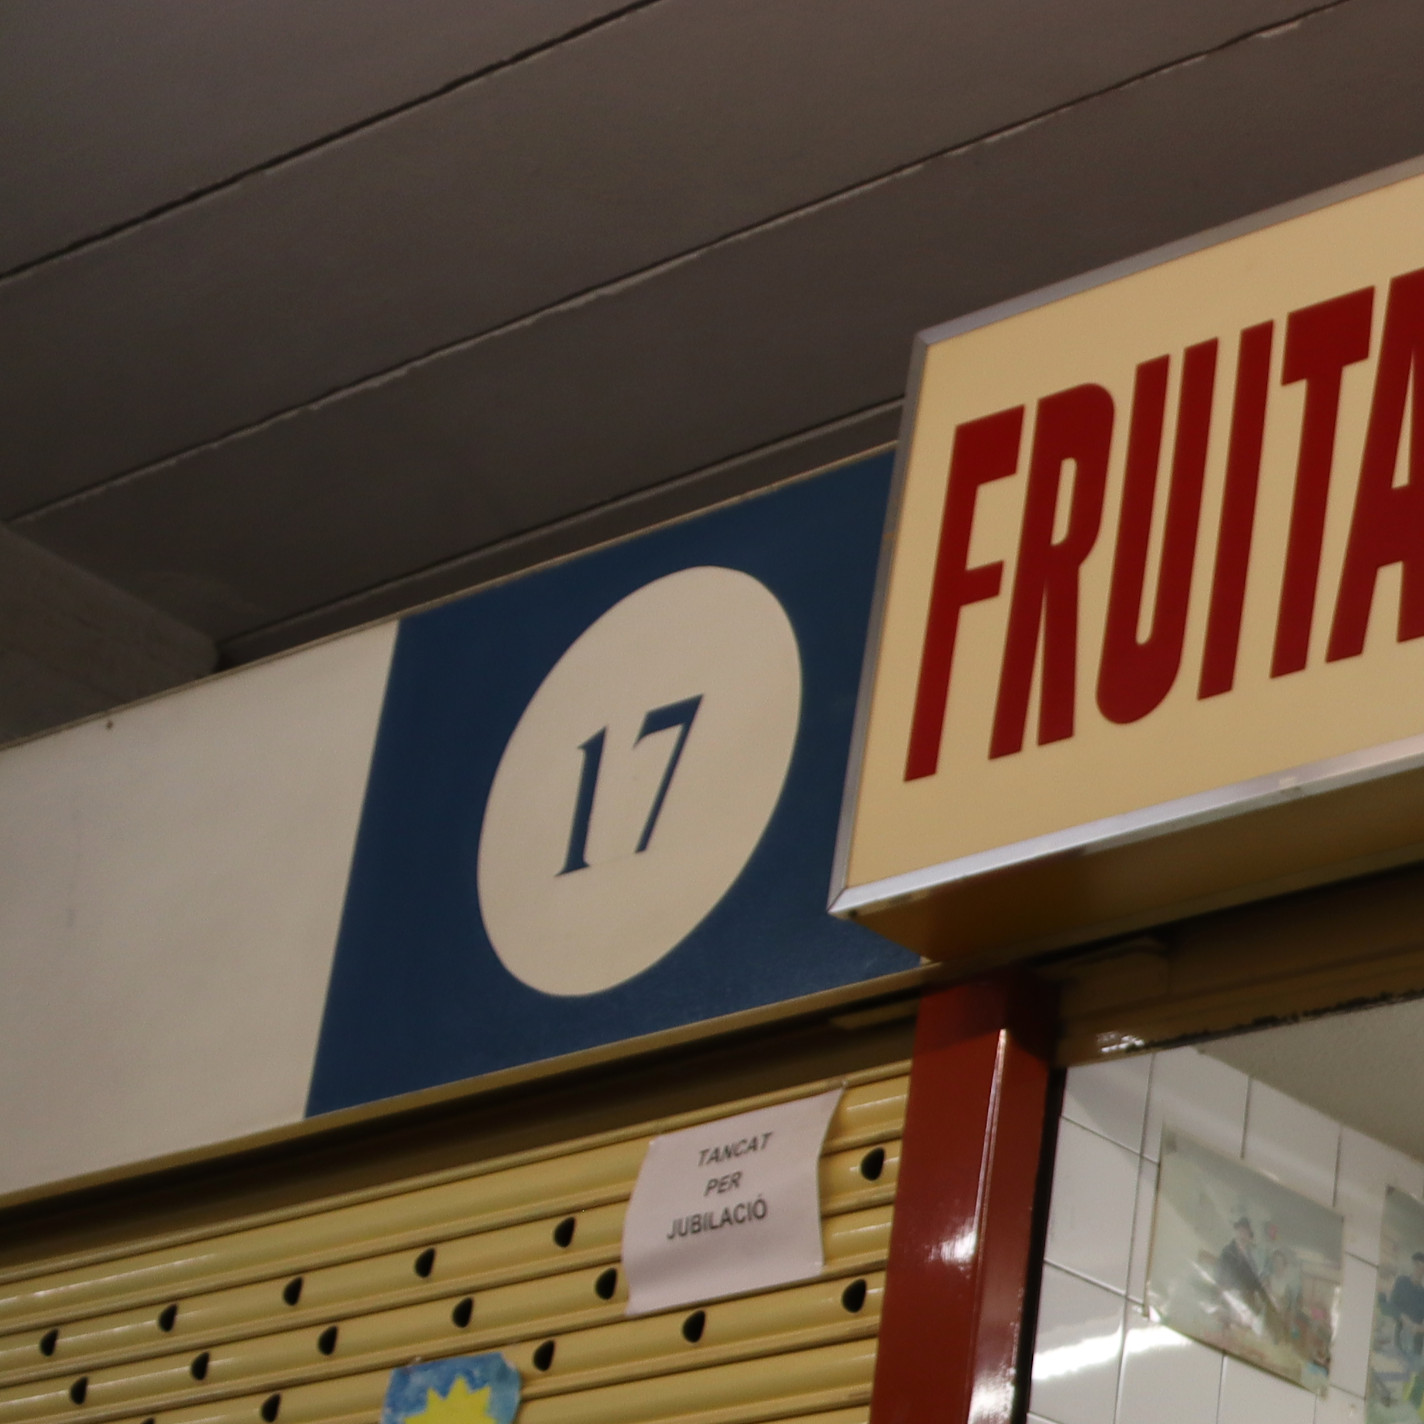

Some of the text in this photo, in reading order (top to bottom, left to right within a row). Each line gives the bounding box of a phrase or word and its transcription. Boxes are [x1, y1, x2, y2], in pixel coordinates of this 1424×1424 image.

[555, 694, 705, 877] 17
[698, 1131, 772, 1167] TANCAT
[704, 1171, 742, 1197] PER
[667, 1193, 768, 1240] JUBILACIÓ
